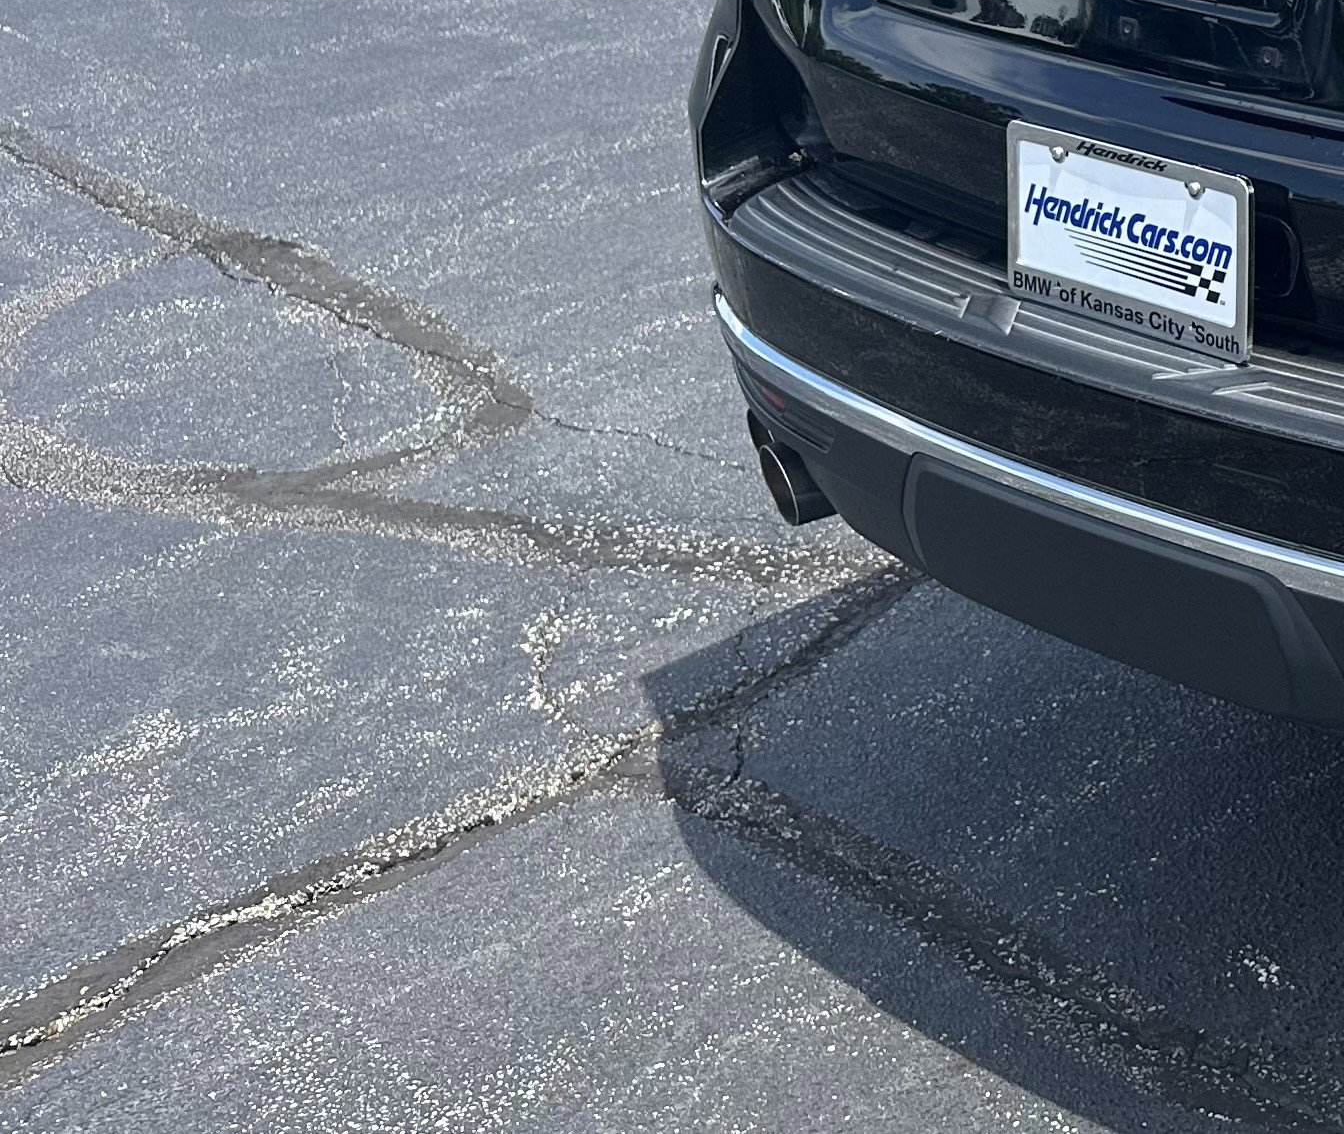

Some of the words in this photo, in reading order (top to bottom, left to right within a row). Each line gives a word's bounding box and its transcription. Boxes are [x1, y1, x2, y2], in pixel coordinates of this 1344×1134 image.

[1076, 141, 1168, 172] Hendrick
[1013, 270, 1051, 296] BMW
[1059, 287, 1077, 303] of
[1080, 290, 1144, 325] Kansas
[1149, 311, 1185, 340] City
[1194, 325, 1240, 355] South
